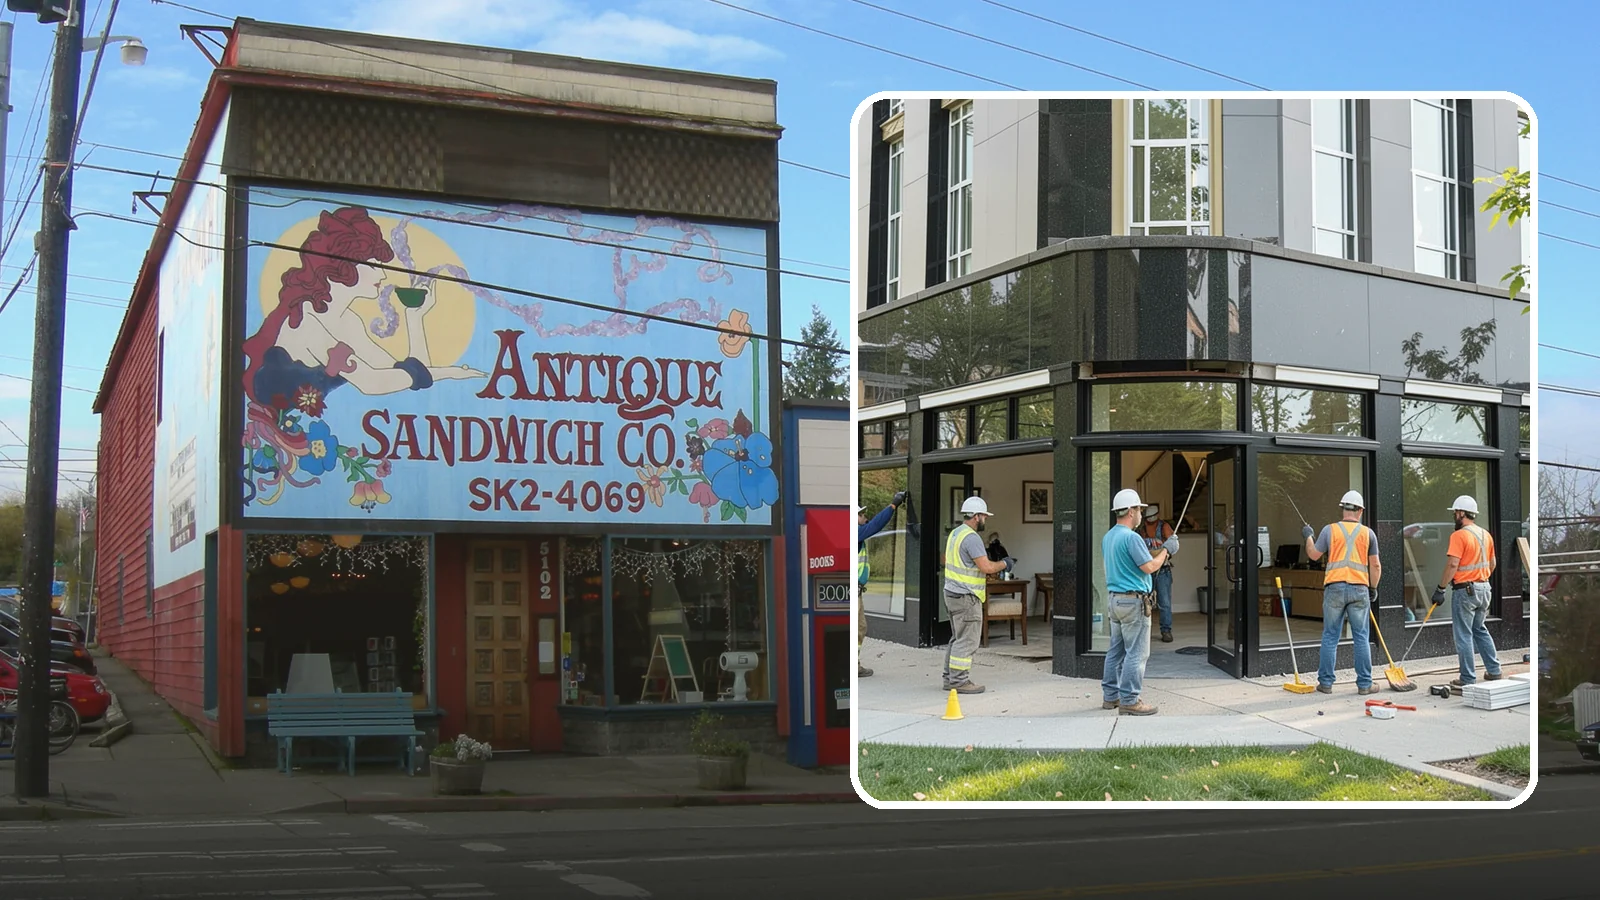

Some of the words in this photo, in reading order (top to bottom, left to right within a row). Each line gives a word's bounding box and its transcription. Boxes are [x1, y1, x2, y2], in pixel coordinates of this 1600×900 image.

[475, 329, 723, 420] ANTIQUE
[361, 408, 604, 467] SANDWICH
[617, 419, 685, 469] CO.
[468, 477, 646, 513] SK2-4069
[539, 541, 552, 599] 5102
[809, 555, 835, 569] BOOKS
